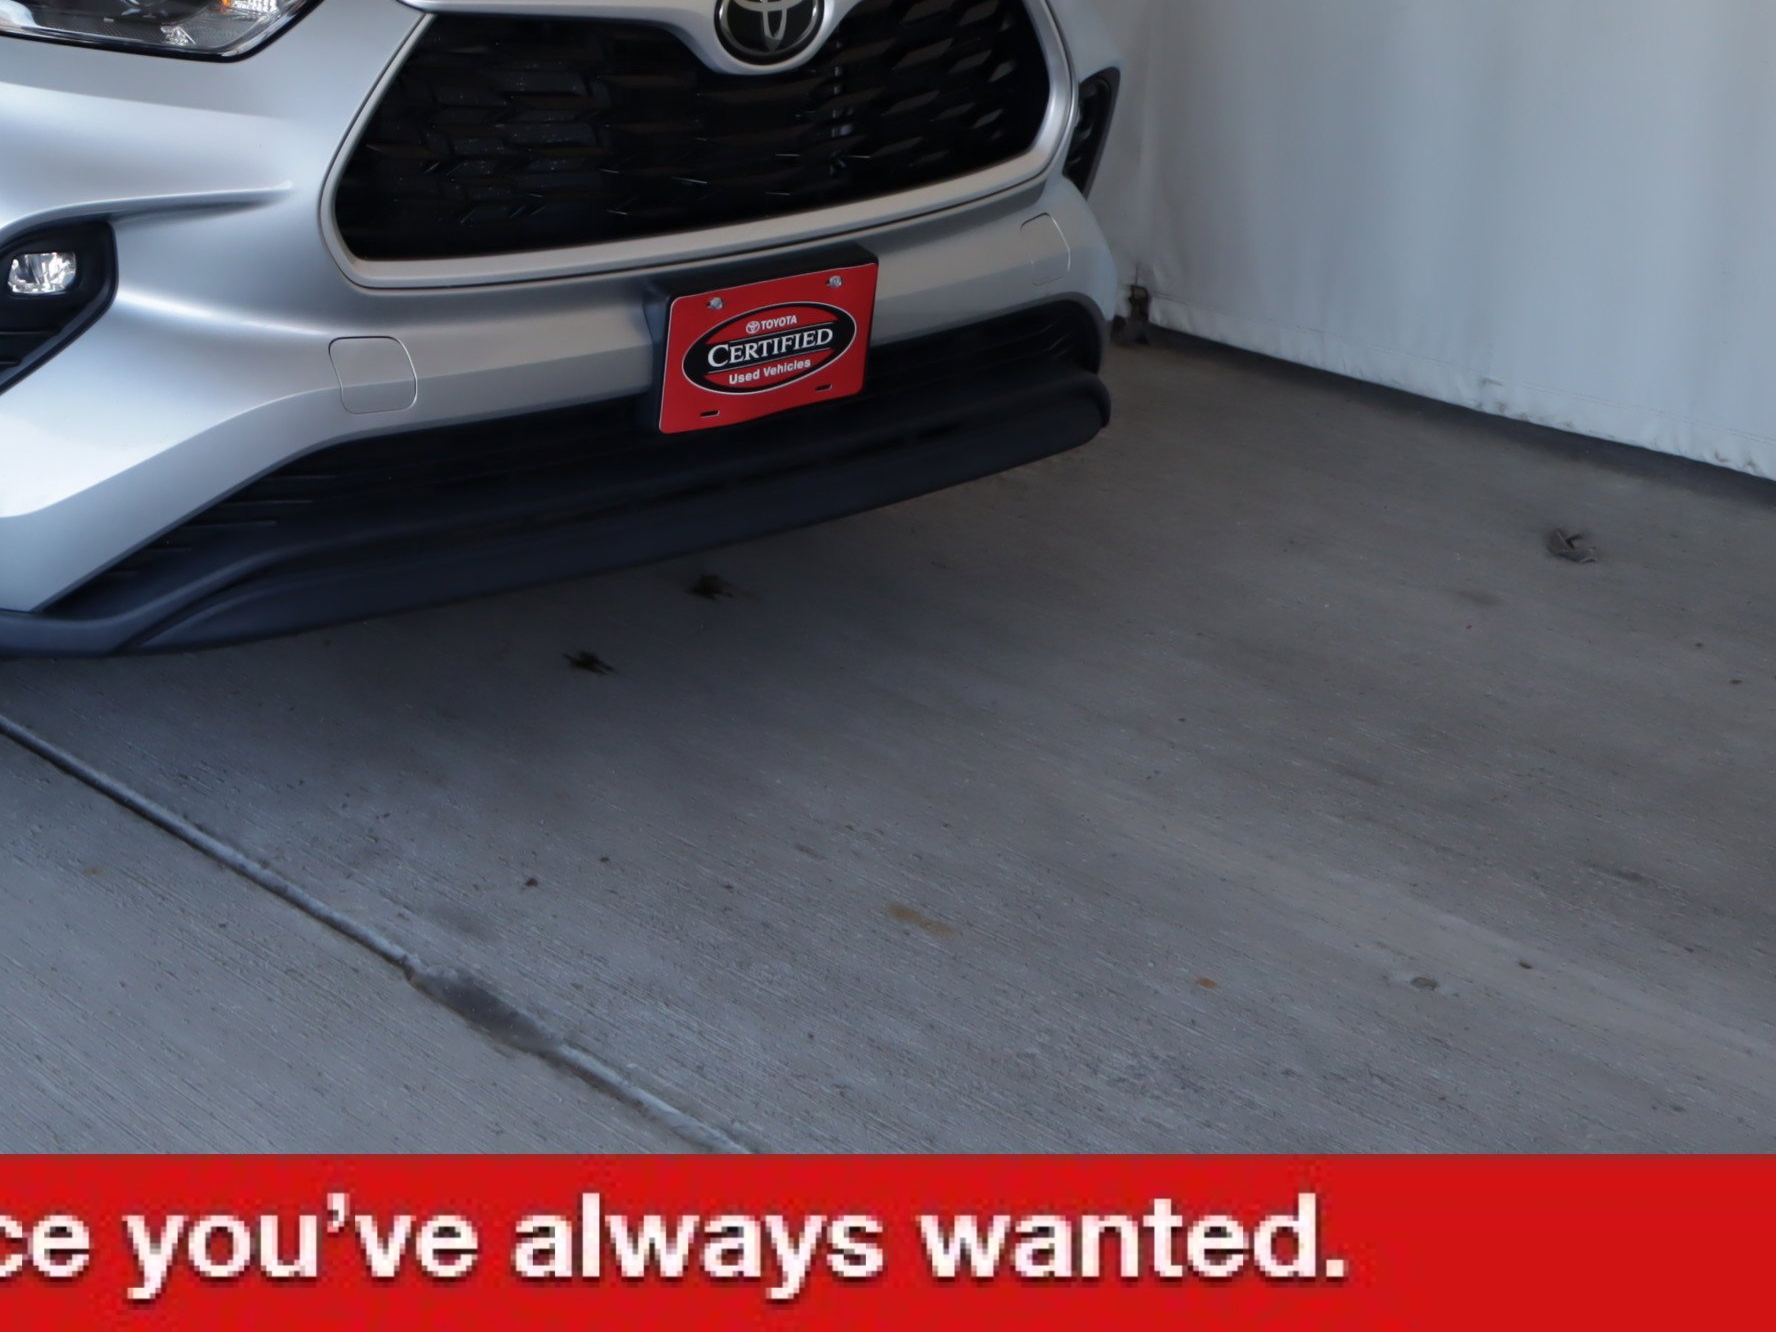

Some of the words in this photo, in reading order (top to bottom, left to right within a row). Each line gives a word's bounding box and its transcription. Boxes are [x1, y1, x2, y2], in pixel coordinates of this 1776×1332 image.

[761, 315, 798, 330] TOYOTA
[707, 328, 833, 367] CERTIFIED
[729, 369, 760, 384] Used
[764, 358, 811, 377] Vehicles
